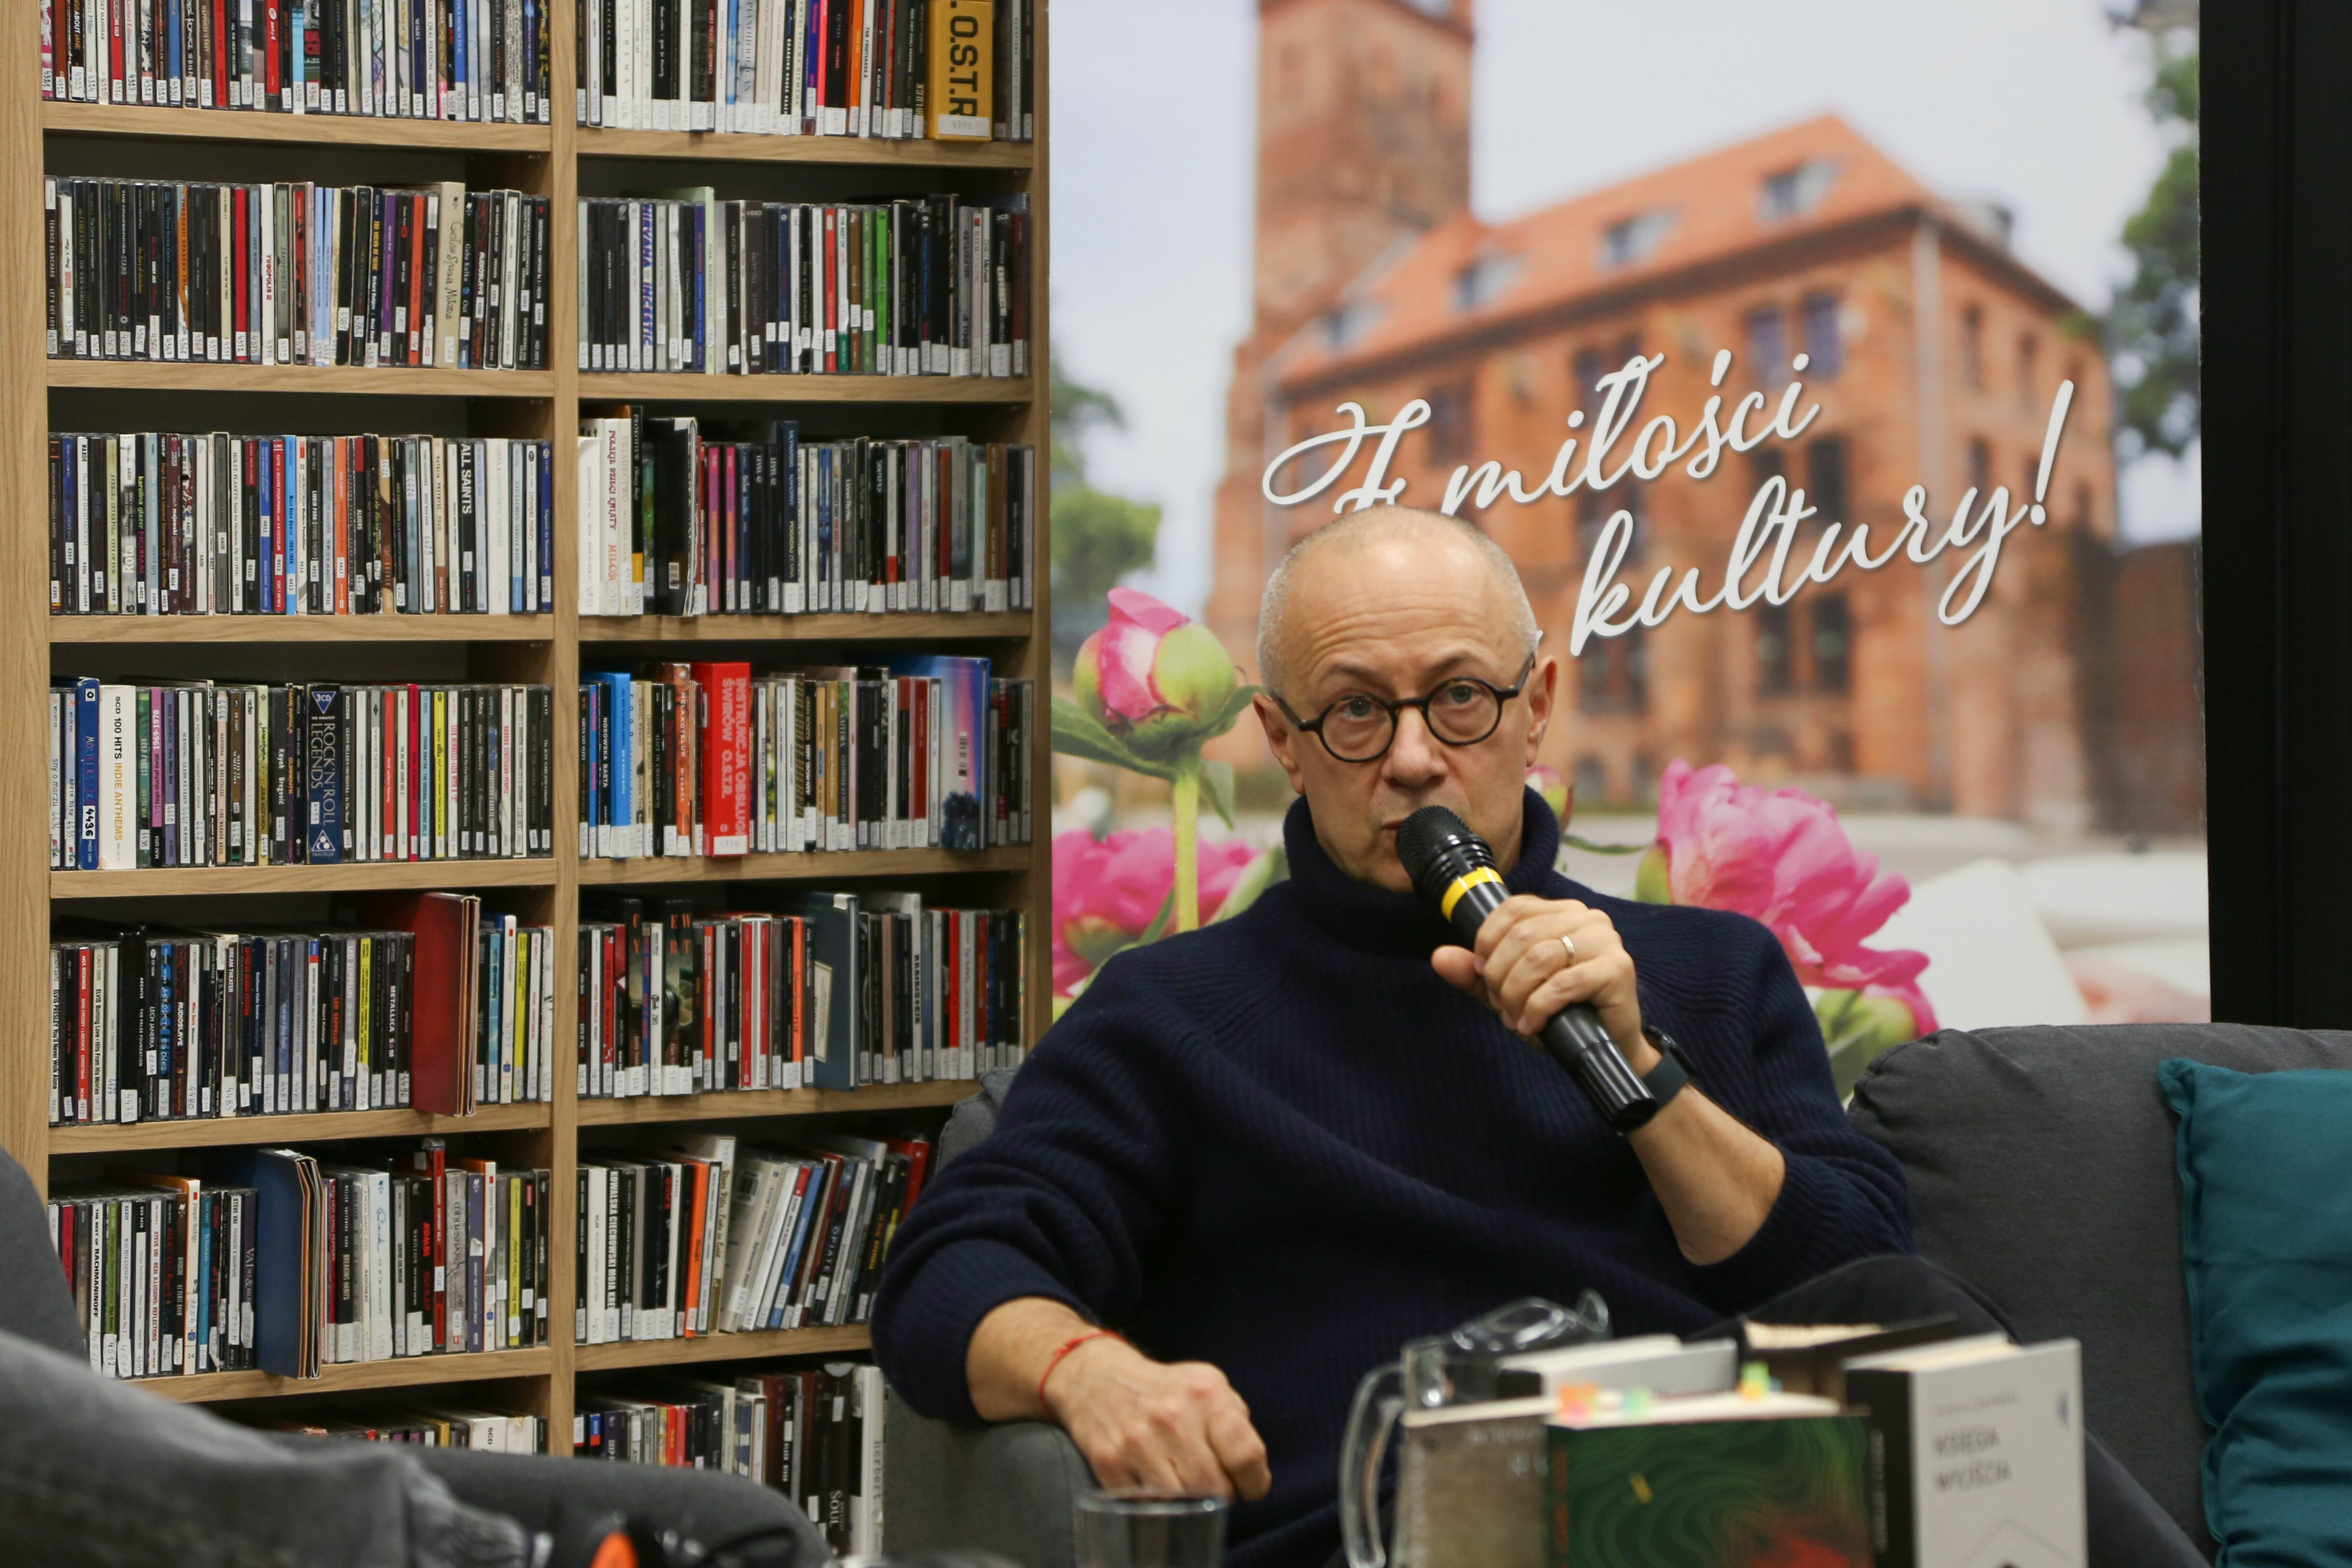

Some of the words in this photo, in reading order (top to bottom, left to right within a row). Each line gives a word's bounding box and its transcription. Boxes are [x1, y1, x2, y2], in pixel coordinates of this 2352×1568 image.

[1441, 348, 1821, 515] miłości
[461, 444, 471, 466] ALL
[462, 469, 472, 514] SAINTS
[771, 477, 776, 485] 42
[1570, 380, 2075, 657] kultury!
[123, 545, 135, 573] Rota
[608, 544, 617, 581] MIŁOŚ
[316, 693, 330, 702] 3CD
[722, 678, 733, 741] ŚWIRÓW
[735, 678, 746, 769] INSTRUKCJA
[311, 724, 322, 789] LEGENDS
[323, 723, 335, 826] ROCK'N'ROLL
[124, 1094, 133, 1117] 4475
[609, 1172, 618, 1215] KOWALSKA
[608, 1216, 617, 1267] CIECHOWSKI
[823, 1226, 839, 1271] OPIATE
[607, 1292, 615, 1309] KRE
[608, 1269, 616, 1290] MOJA
[873, 1441, 882, 1500] herbert
[829, 1491, 841, 1527] SOUL
